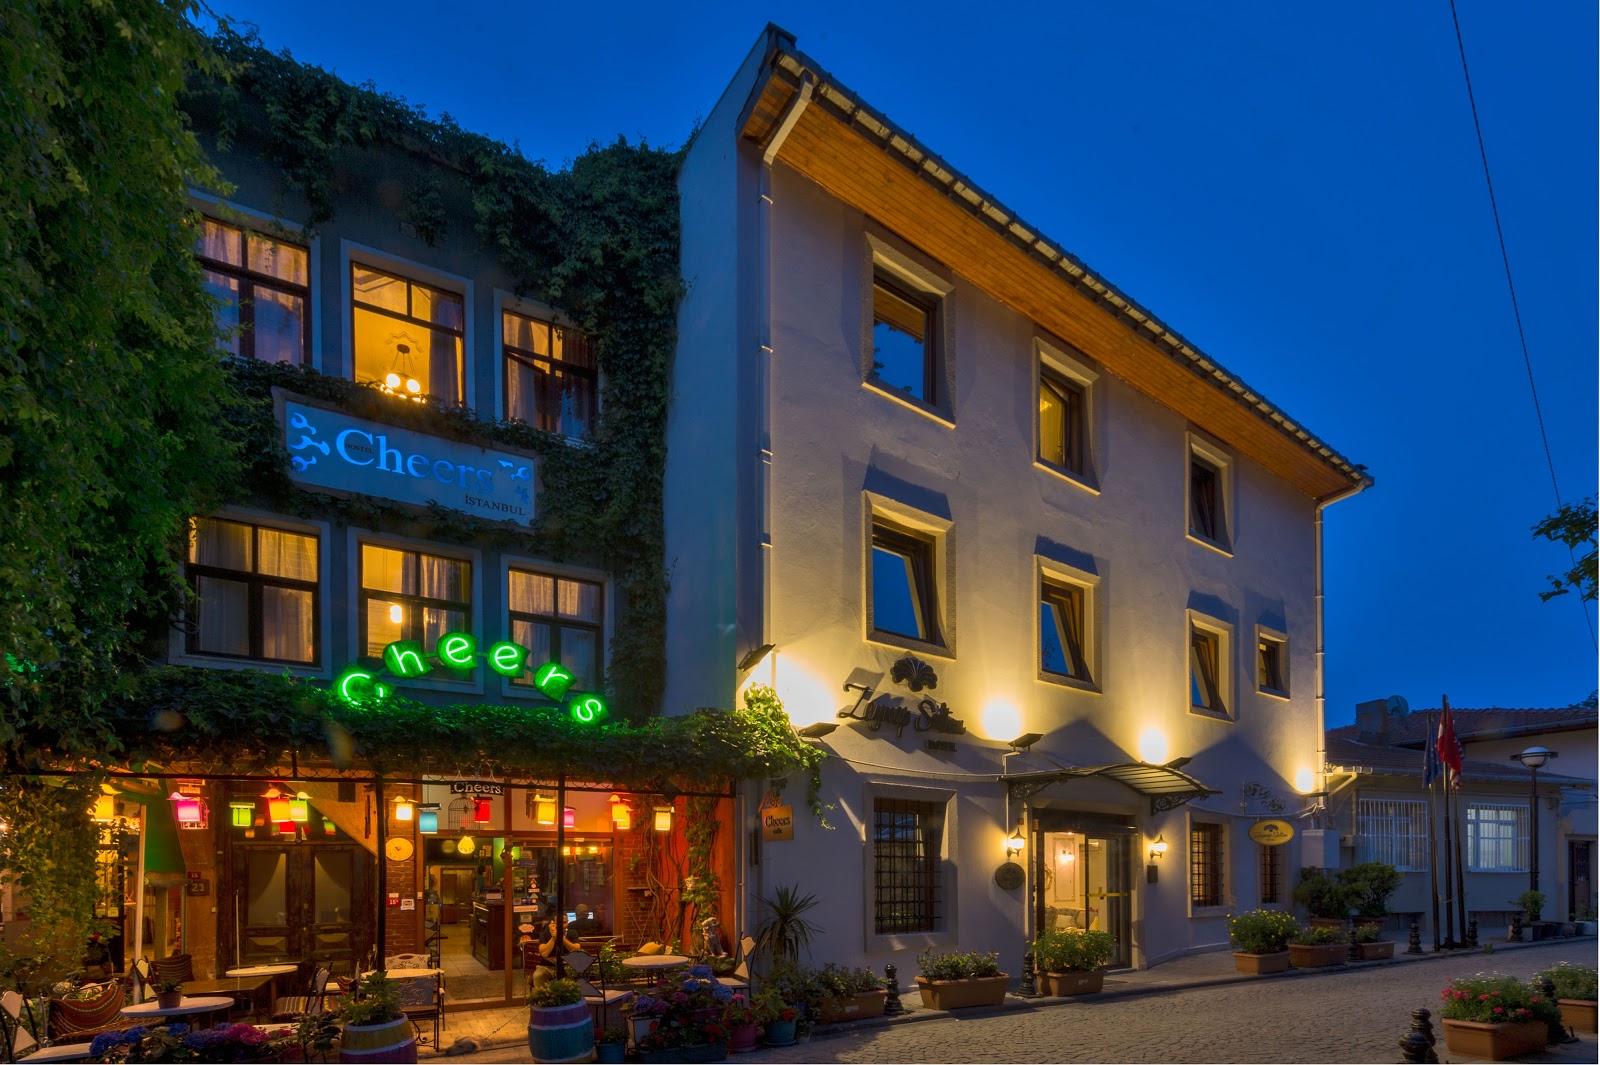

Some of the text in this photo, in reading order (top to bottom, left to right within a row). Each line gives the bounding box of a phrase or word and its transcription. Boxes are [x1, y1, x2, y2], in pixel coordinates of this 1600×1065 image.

[344, 442, 375, 454] HOSTEL
[336, 429, 495, 494] Cheers
[464, 494, 527, 517] İSTANBUL
[341, 636, 602, 722] Cheers
[453, 781, 502, 795] Cheers
[765, 815, 791, 828] Cheers
[191, 883, 204, 892] 21
